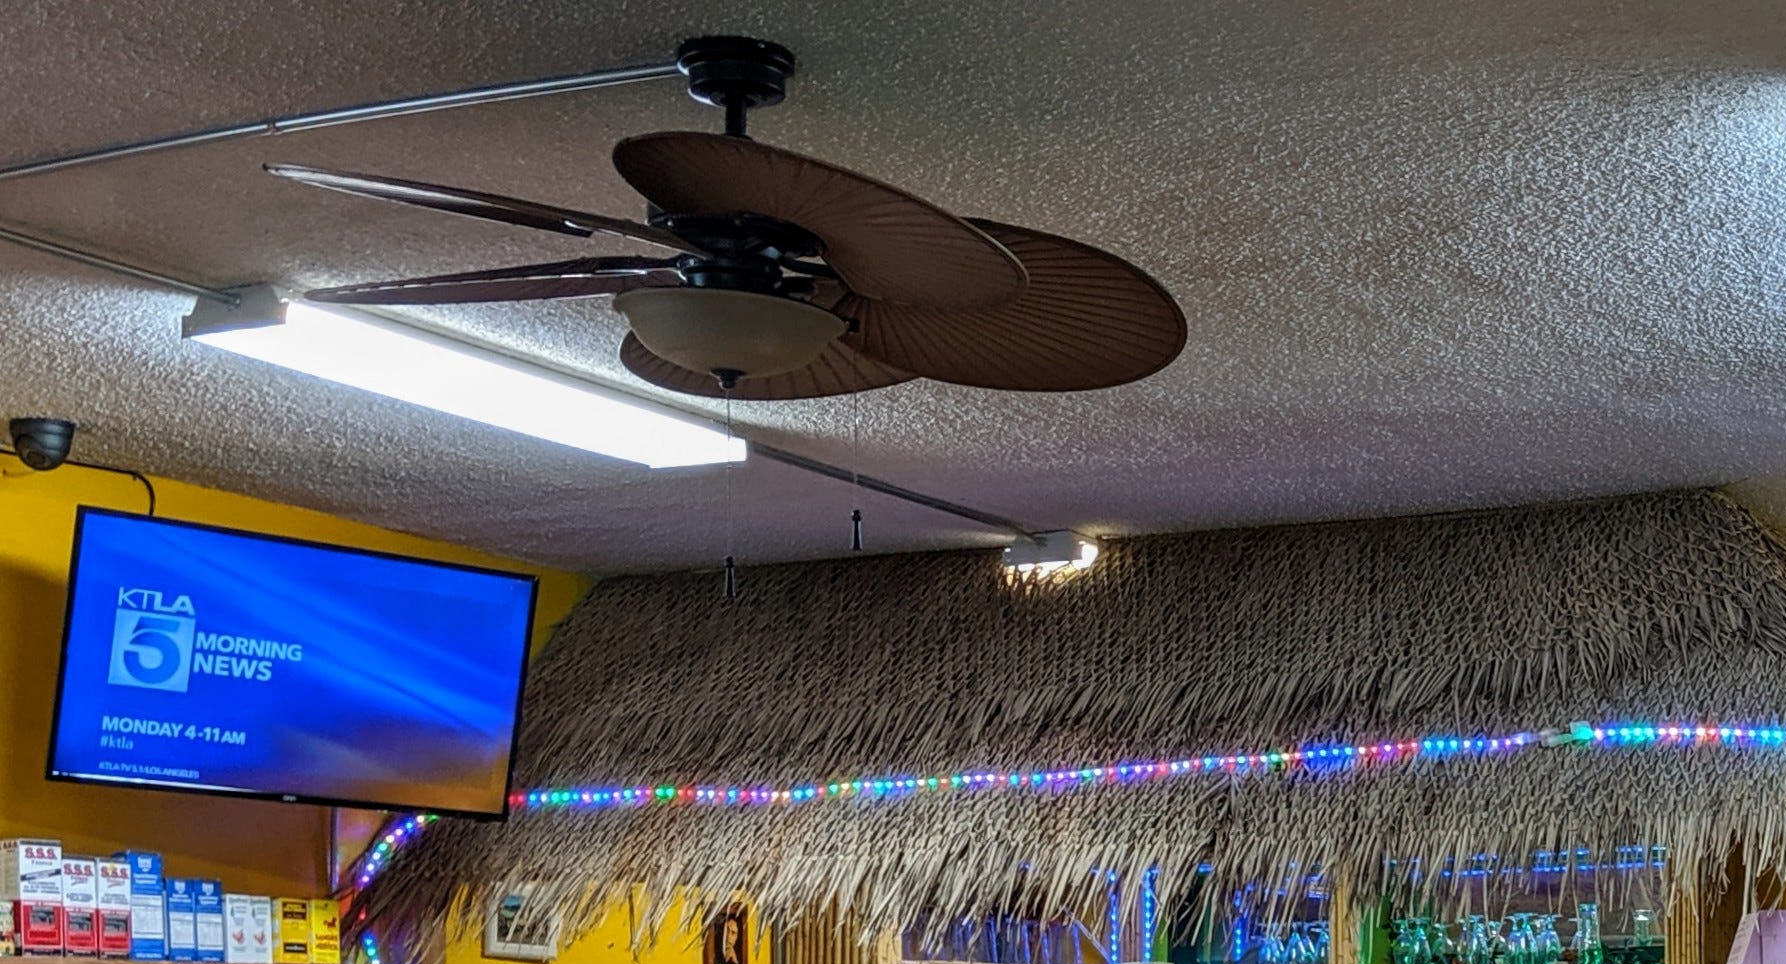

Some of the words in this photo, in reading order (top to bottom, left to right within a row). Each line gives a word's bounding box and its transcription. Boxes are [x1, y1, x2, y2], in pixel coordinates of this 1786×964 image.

[117, 586, 196, 616] KTLA
[123, 615, 181, 685] 5
[195, 631, 303, 662] MORNING
[193, 652, 273, 682] NEWS
[100, 733, 134, 751] #ktla
[101, 715, 184, 739] MONDAY
